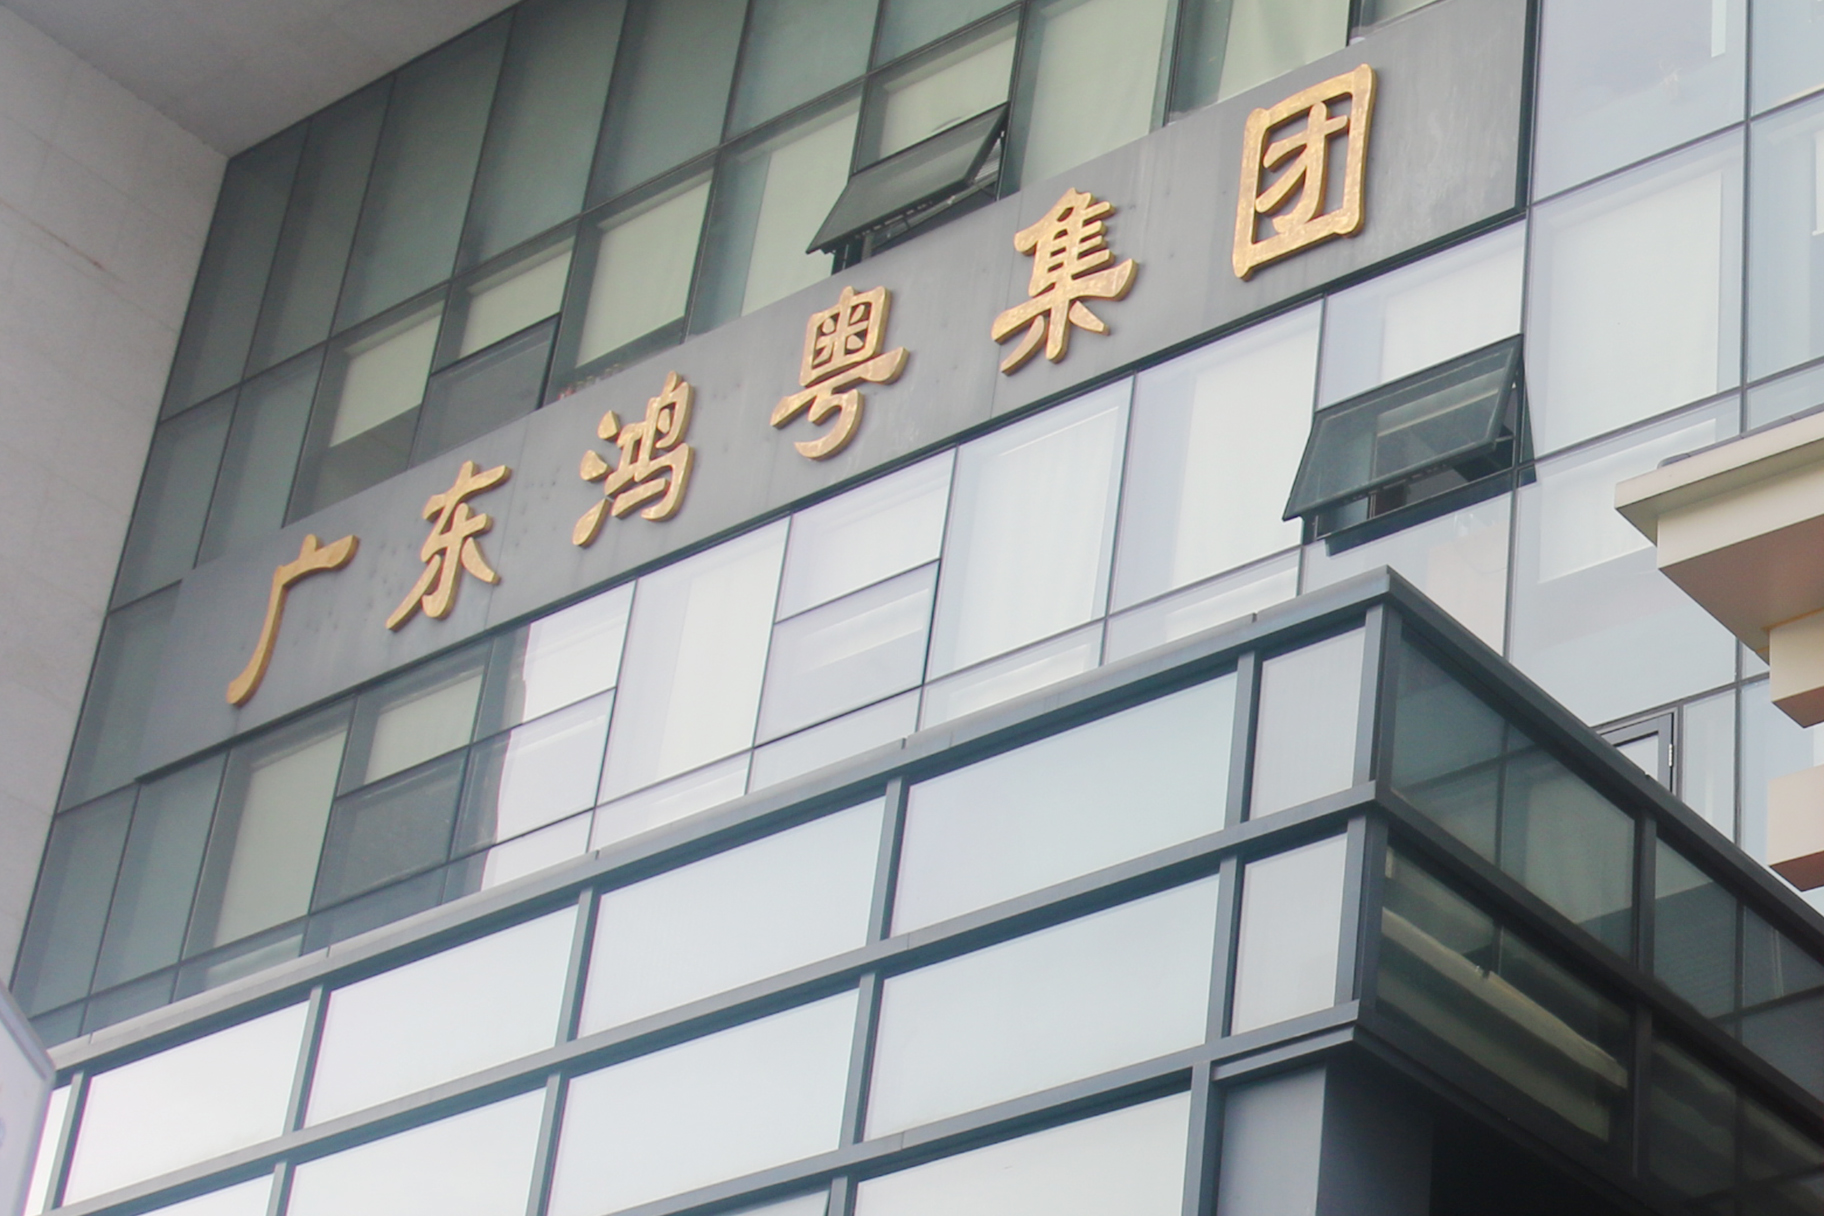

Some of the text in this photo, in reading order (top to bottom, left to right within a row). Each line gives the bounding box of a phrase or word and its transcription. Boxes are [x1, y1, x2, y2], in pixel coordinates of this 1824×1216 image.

[226, 62, 1377, 707] 广东鸿粤集团
